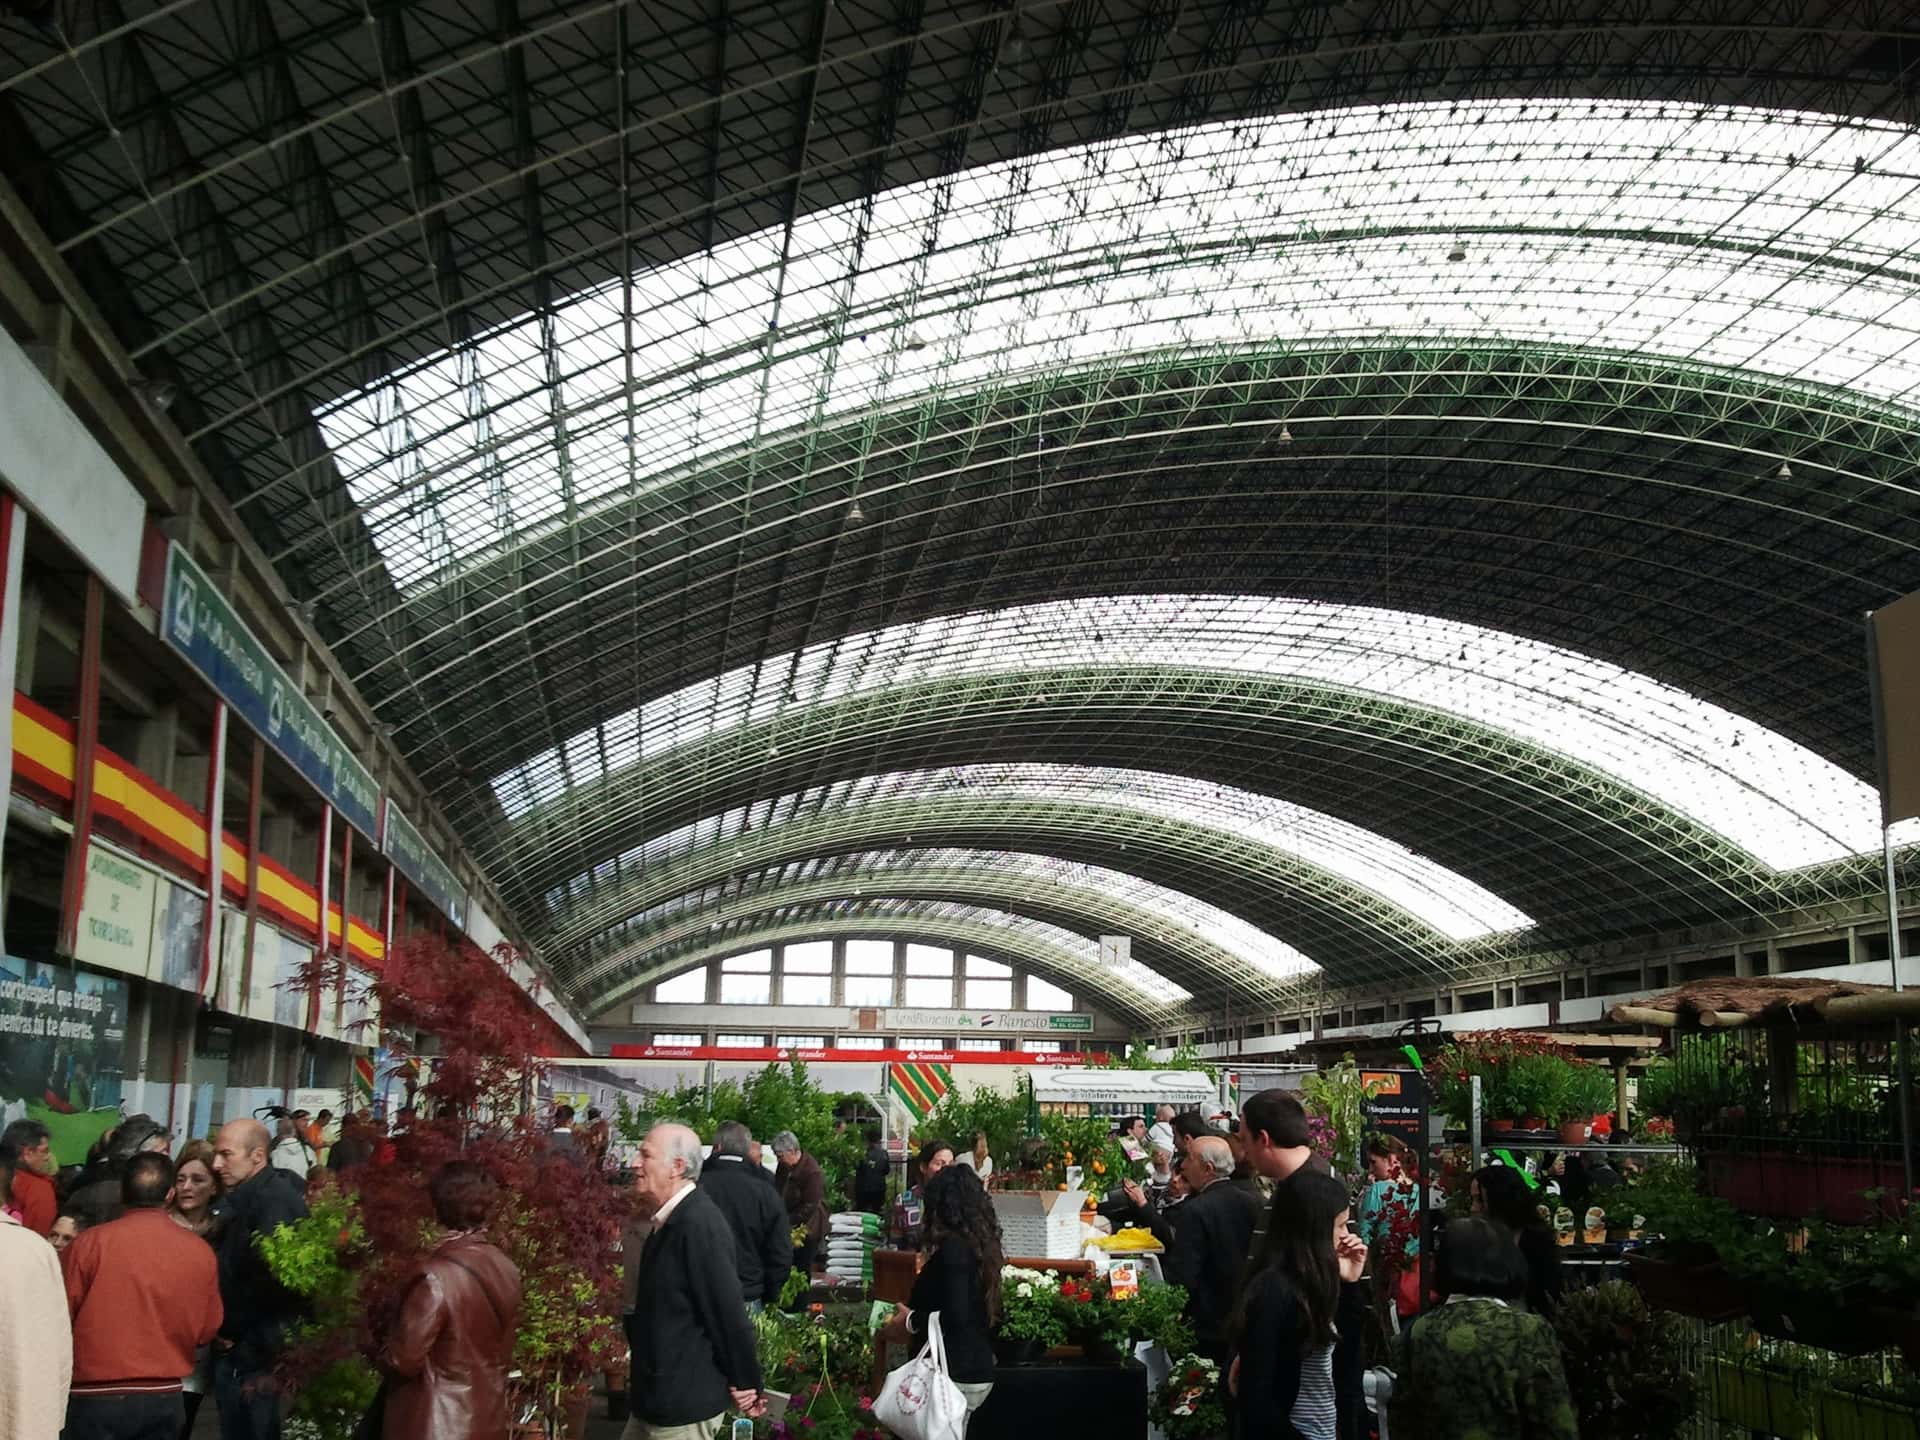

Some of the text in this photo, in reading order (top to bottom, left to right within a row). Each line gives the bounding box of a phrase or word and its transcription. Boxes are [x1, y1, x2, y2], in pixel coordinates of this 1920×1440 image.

[998, 1013, 1048, 1029] Banesto
[655, 1047, 693, 1057] Santander
[917, 1051, 954, 1061] Santander
[1046, 1054, 1081, 1064] Santander
